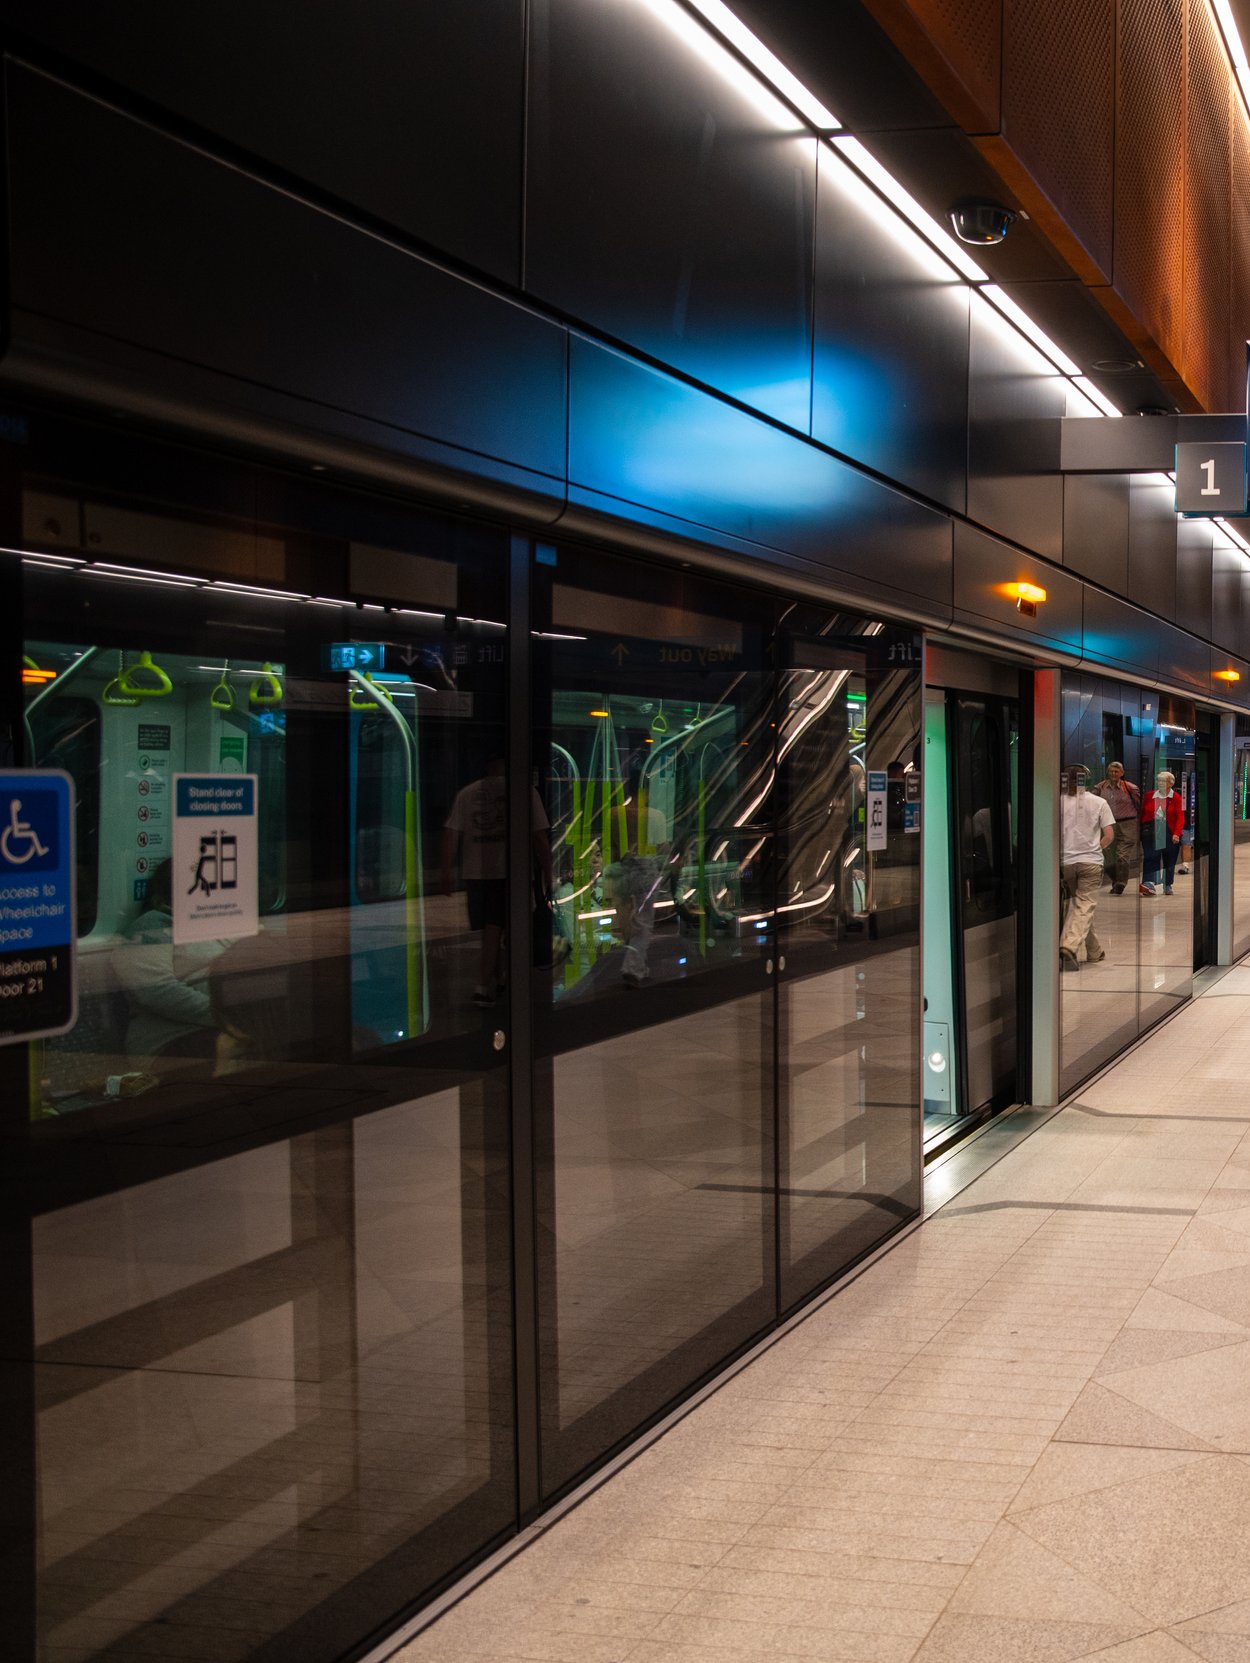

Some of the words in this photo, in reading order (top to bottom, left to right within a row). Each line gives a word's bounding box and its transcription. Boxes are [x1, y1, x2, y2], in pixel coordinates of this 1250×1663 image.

[1200, 459, 1220, 495] 1
[188, 786, 214, 798] Stand
[215, 786, 234, 797] clear
[235, 787, 244, 797] of
[190, 801, 220, 813] closing
[221, 801, 243, 811] doors
[43, 884, 56, 897] to
[51, 954, 58, 972] 1
[27, 977, 44, 995] 21
